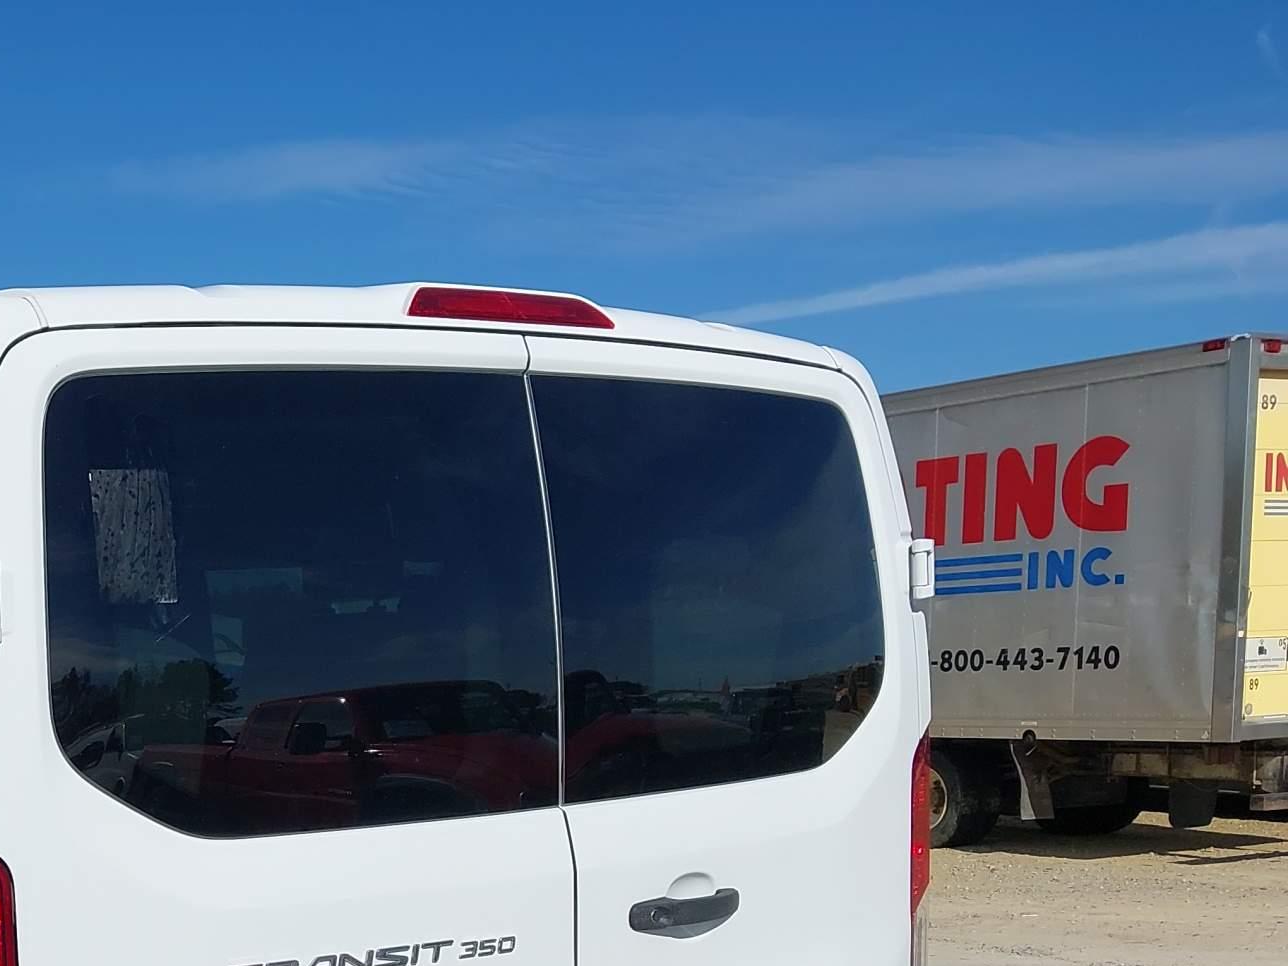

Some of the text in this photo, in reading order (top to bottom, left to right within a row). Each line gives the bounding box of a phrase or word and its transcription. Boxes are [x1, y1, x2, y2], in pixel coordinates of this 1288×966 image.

[1261, 394, 1277, 410] 89
[916, 435, 1131, 548] TING
[1026, 547, 1125, 591] INC.
[1249, 678, 1259, 690] 89
[458, 935, 517, 960] 350
